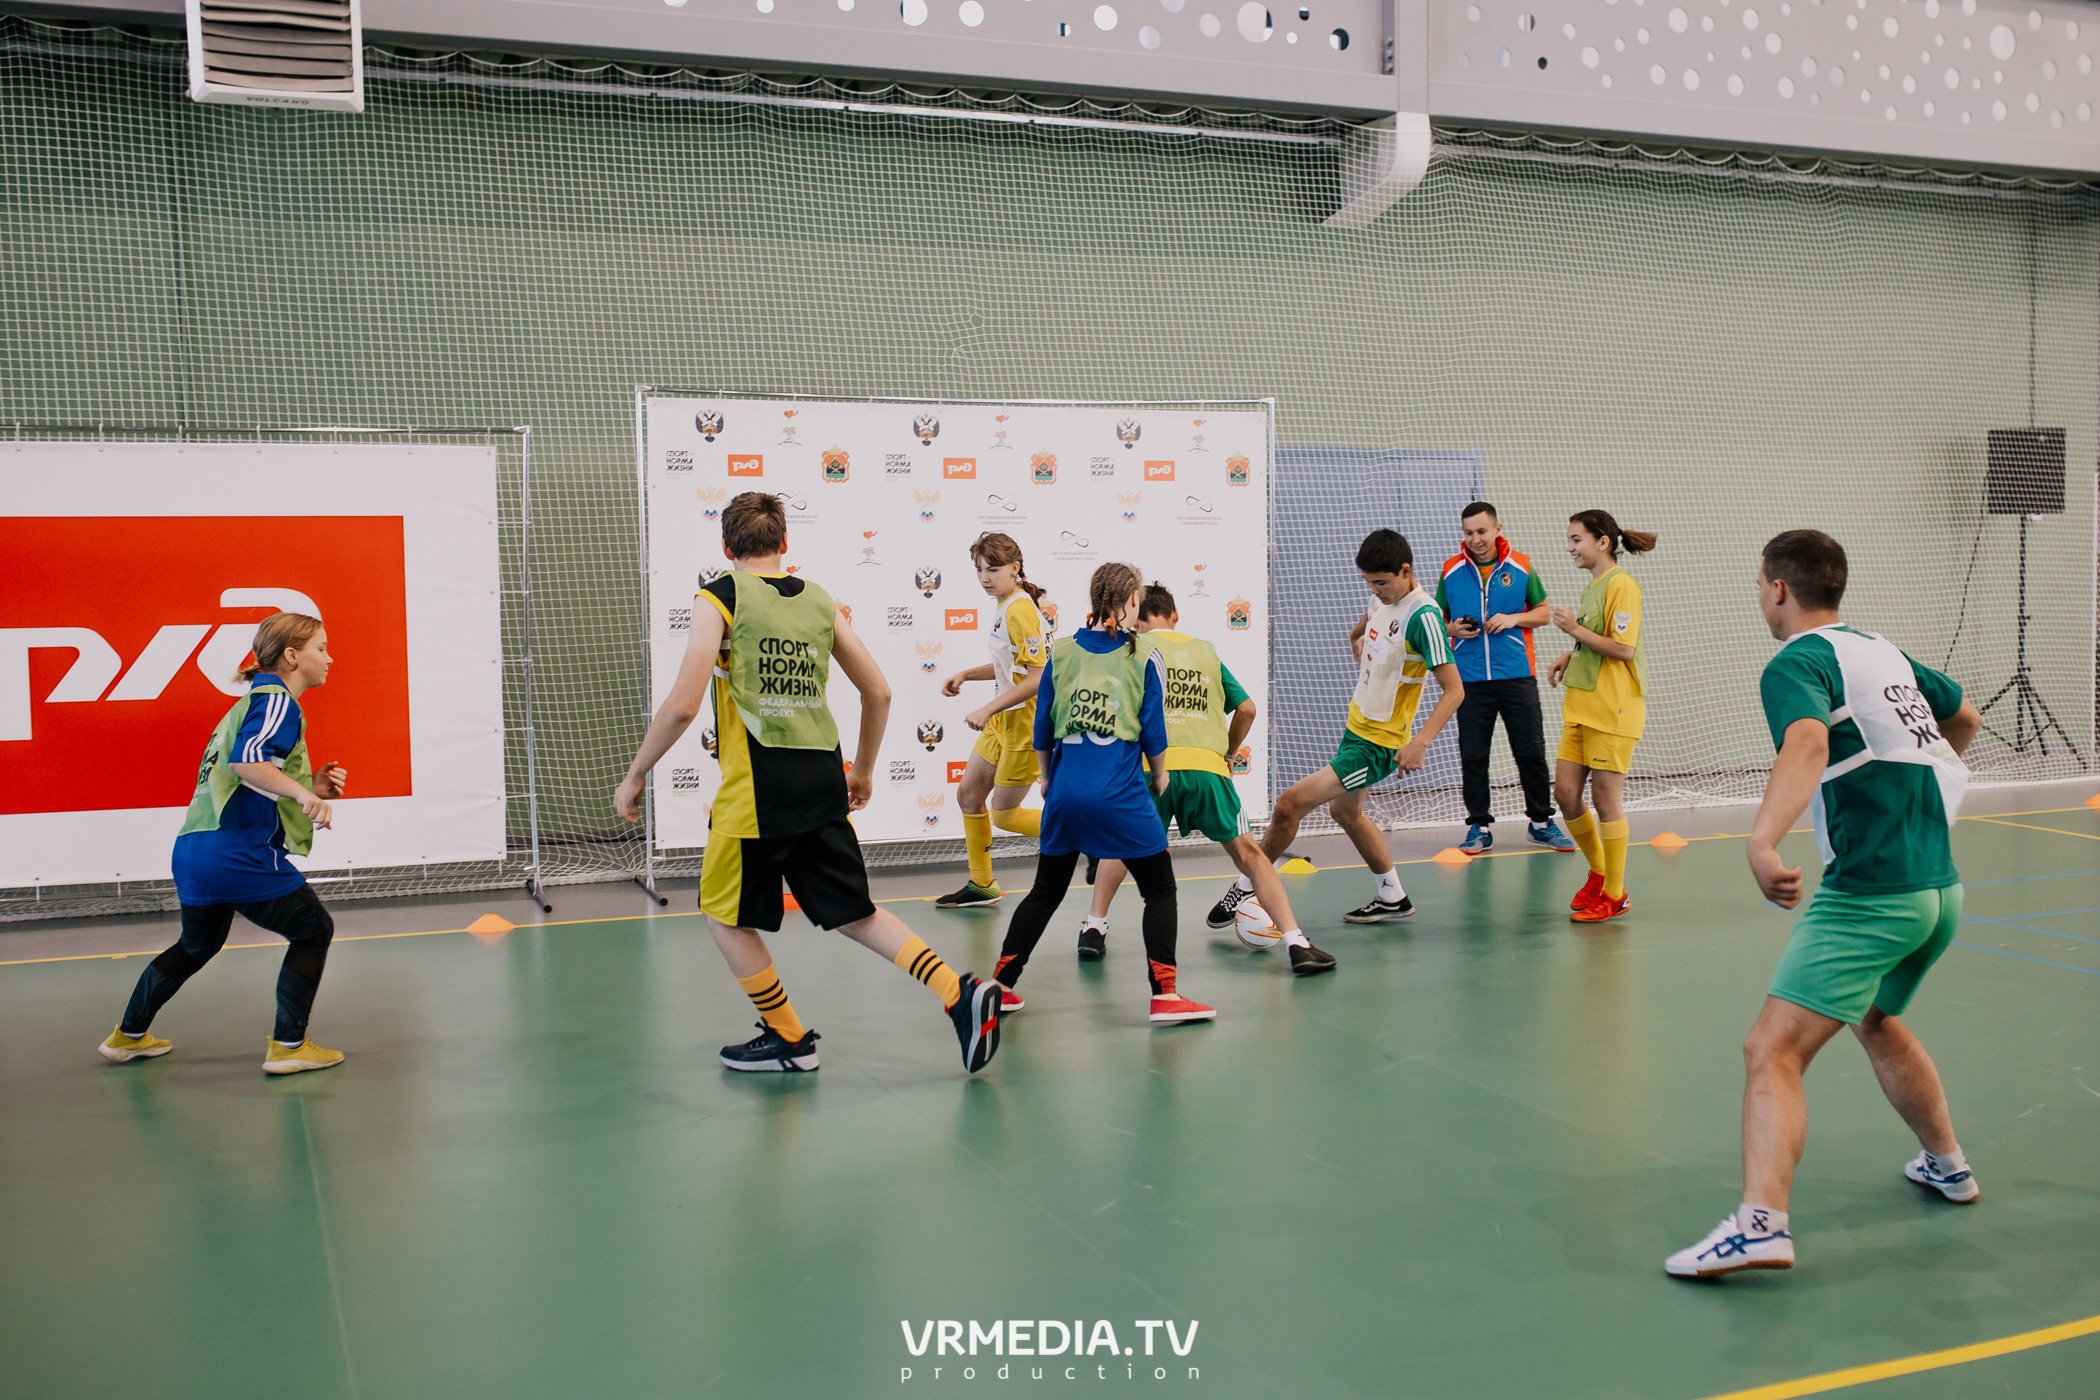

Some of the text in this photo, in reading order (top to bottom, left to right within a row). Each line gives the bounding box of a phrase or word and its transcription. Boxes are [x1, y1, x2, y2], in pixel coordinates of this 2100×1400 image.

[246, 96, 310, 105] VOLCANO
[759, 637, 809, 658] СПОРТ
[1166, 667, 1202, 683] ПОРТ
[758, 677, 821, 697] ЖИЗНИ
[1884, 684, 1921, 703] СПО
[758, 697, 823, 709] ФЕДЕРАЛЬНЫЙ
[759, 708, 795, 718] ПРОЕКТ
[1070, 704, 1117, 728] ОРМА
[672, 782, 699, 790] ЖИЗНИ
